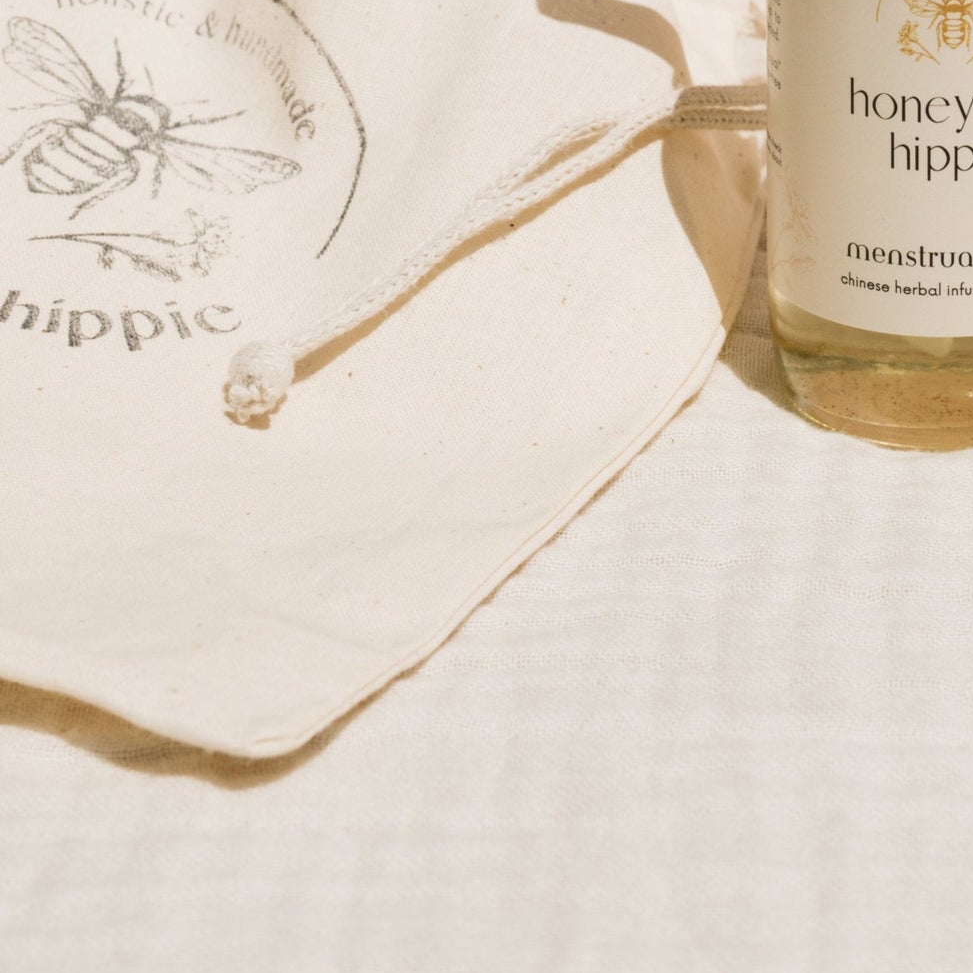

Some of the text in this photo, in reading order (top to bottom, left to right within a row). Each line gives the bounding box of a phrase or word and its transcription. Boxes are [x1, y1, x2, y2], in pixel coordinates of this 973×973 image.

[195, 10, 216, 39] &
[840, 271, 890, 294] chinese
[894, 279, 942, 297] herbal
[0, 289, 242, 352] hippie
